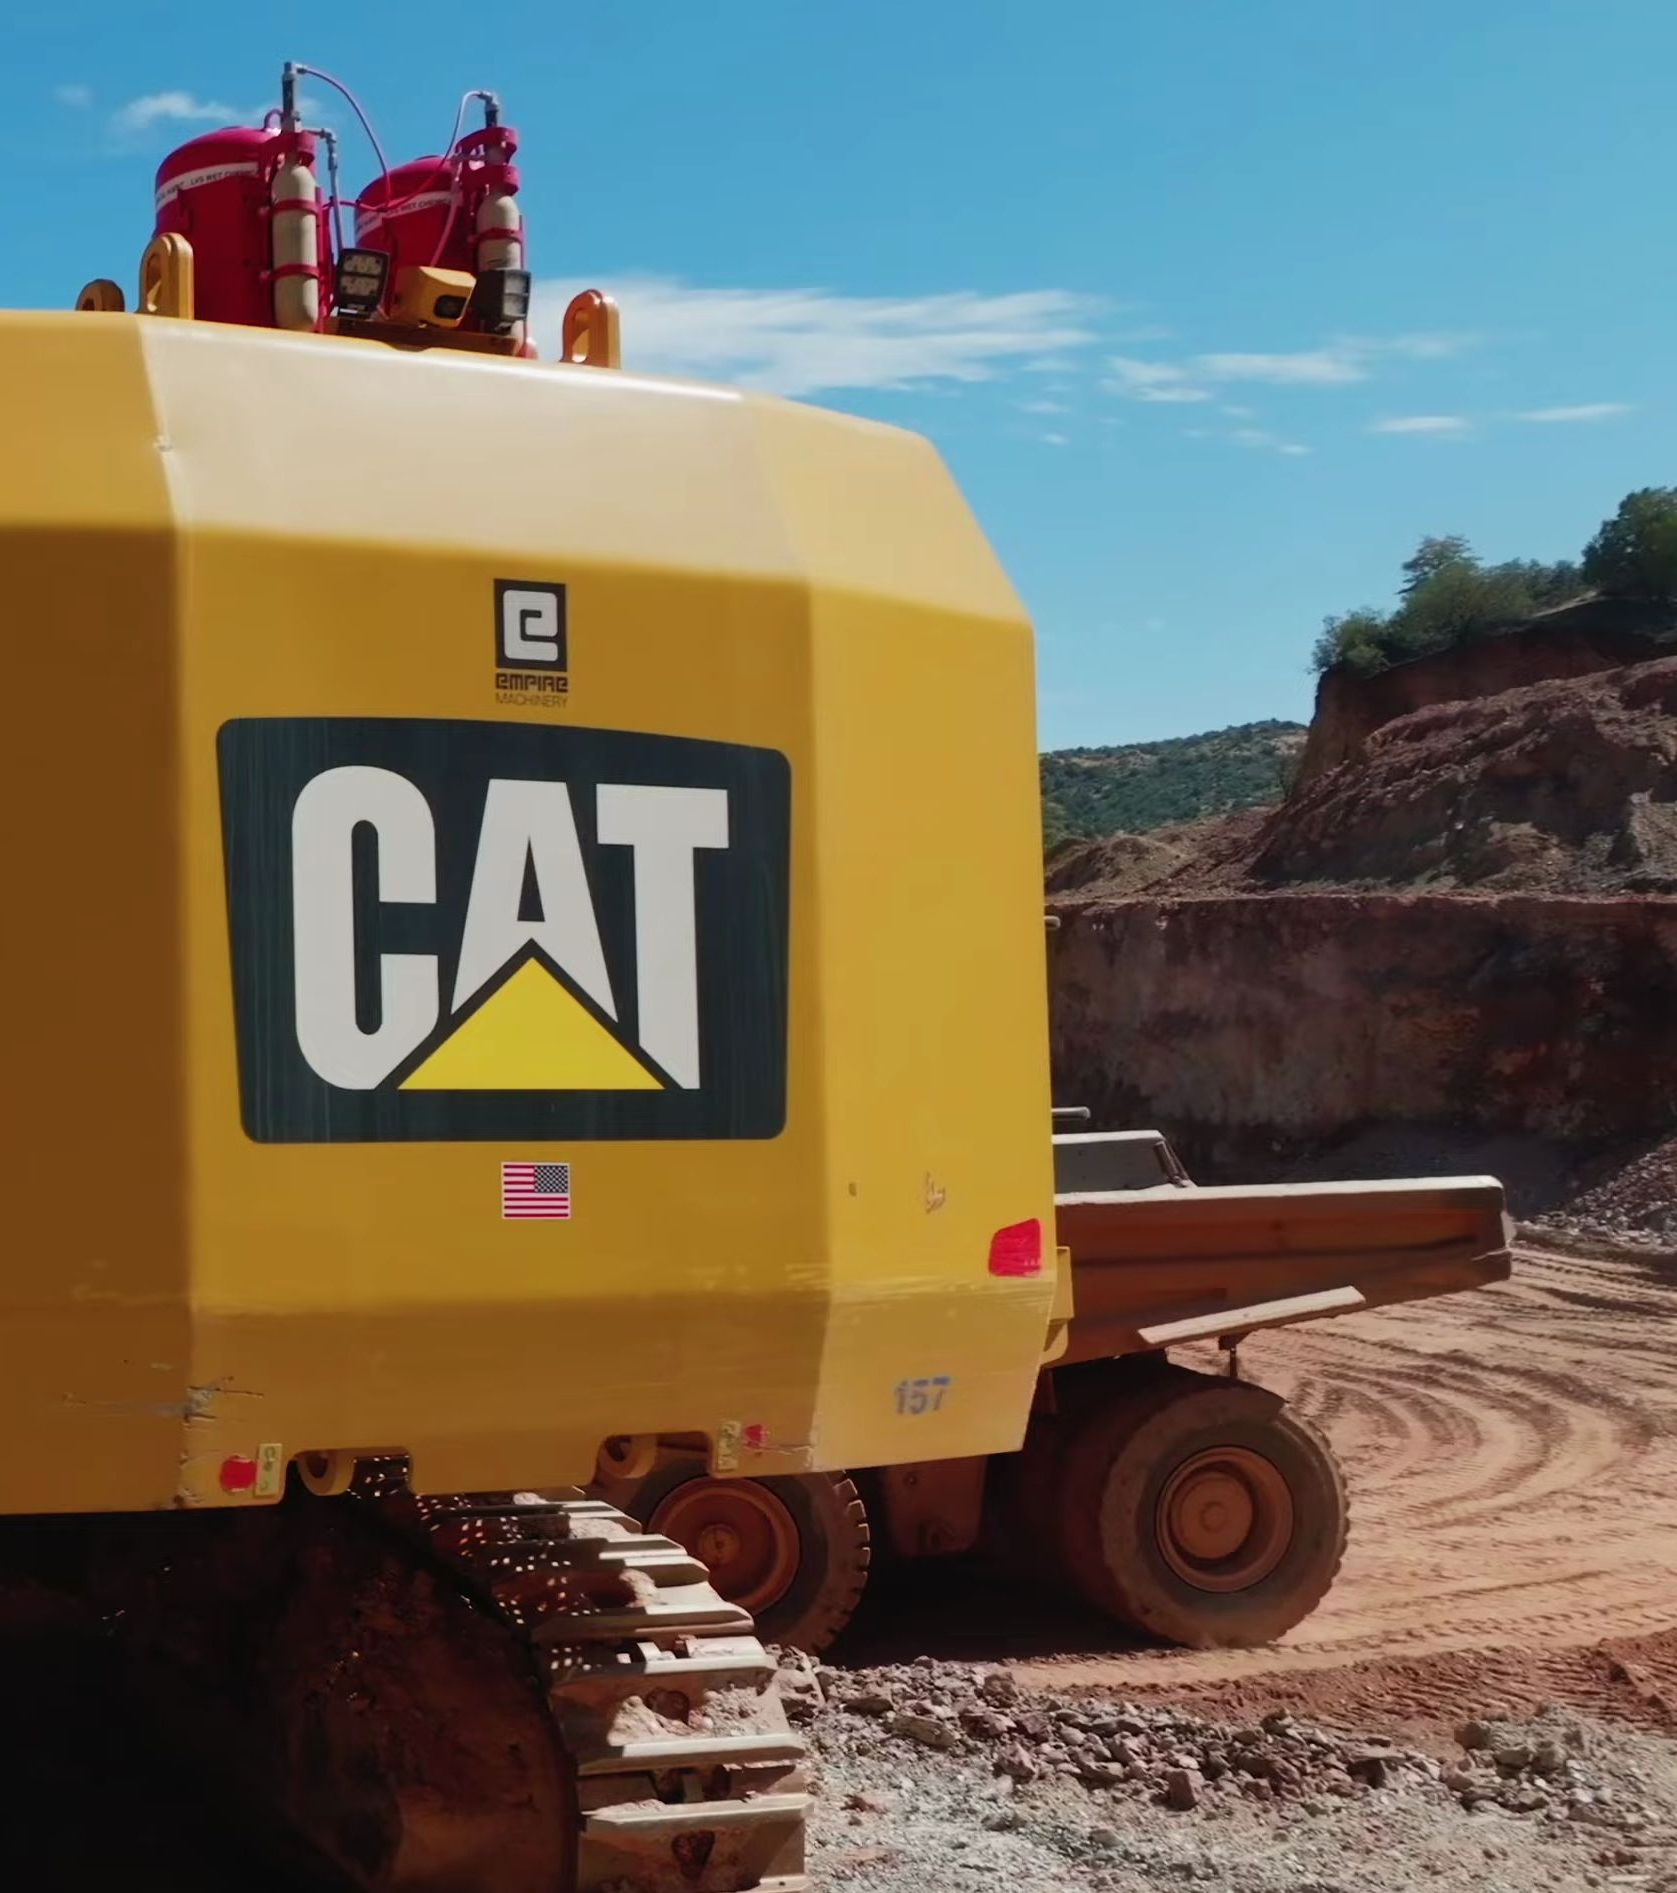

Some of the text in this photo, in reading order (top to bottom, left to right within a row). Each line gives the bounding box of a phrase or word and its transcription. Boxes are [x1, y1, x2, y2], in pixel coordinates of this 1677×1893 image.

[495, 692, 568, 709] MACHINERY
[291, 765, 730, 1090] CAT
[896, 1376, 952, 1415] 157
